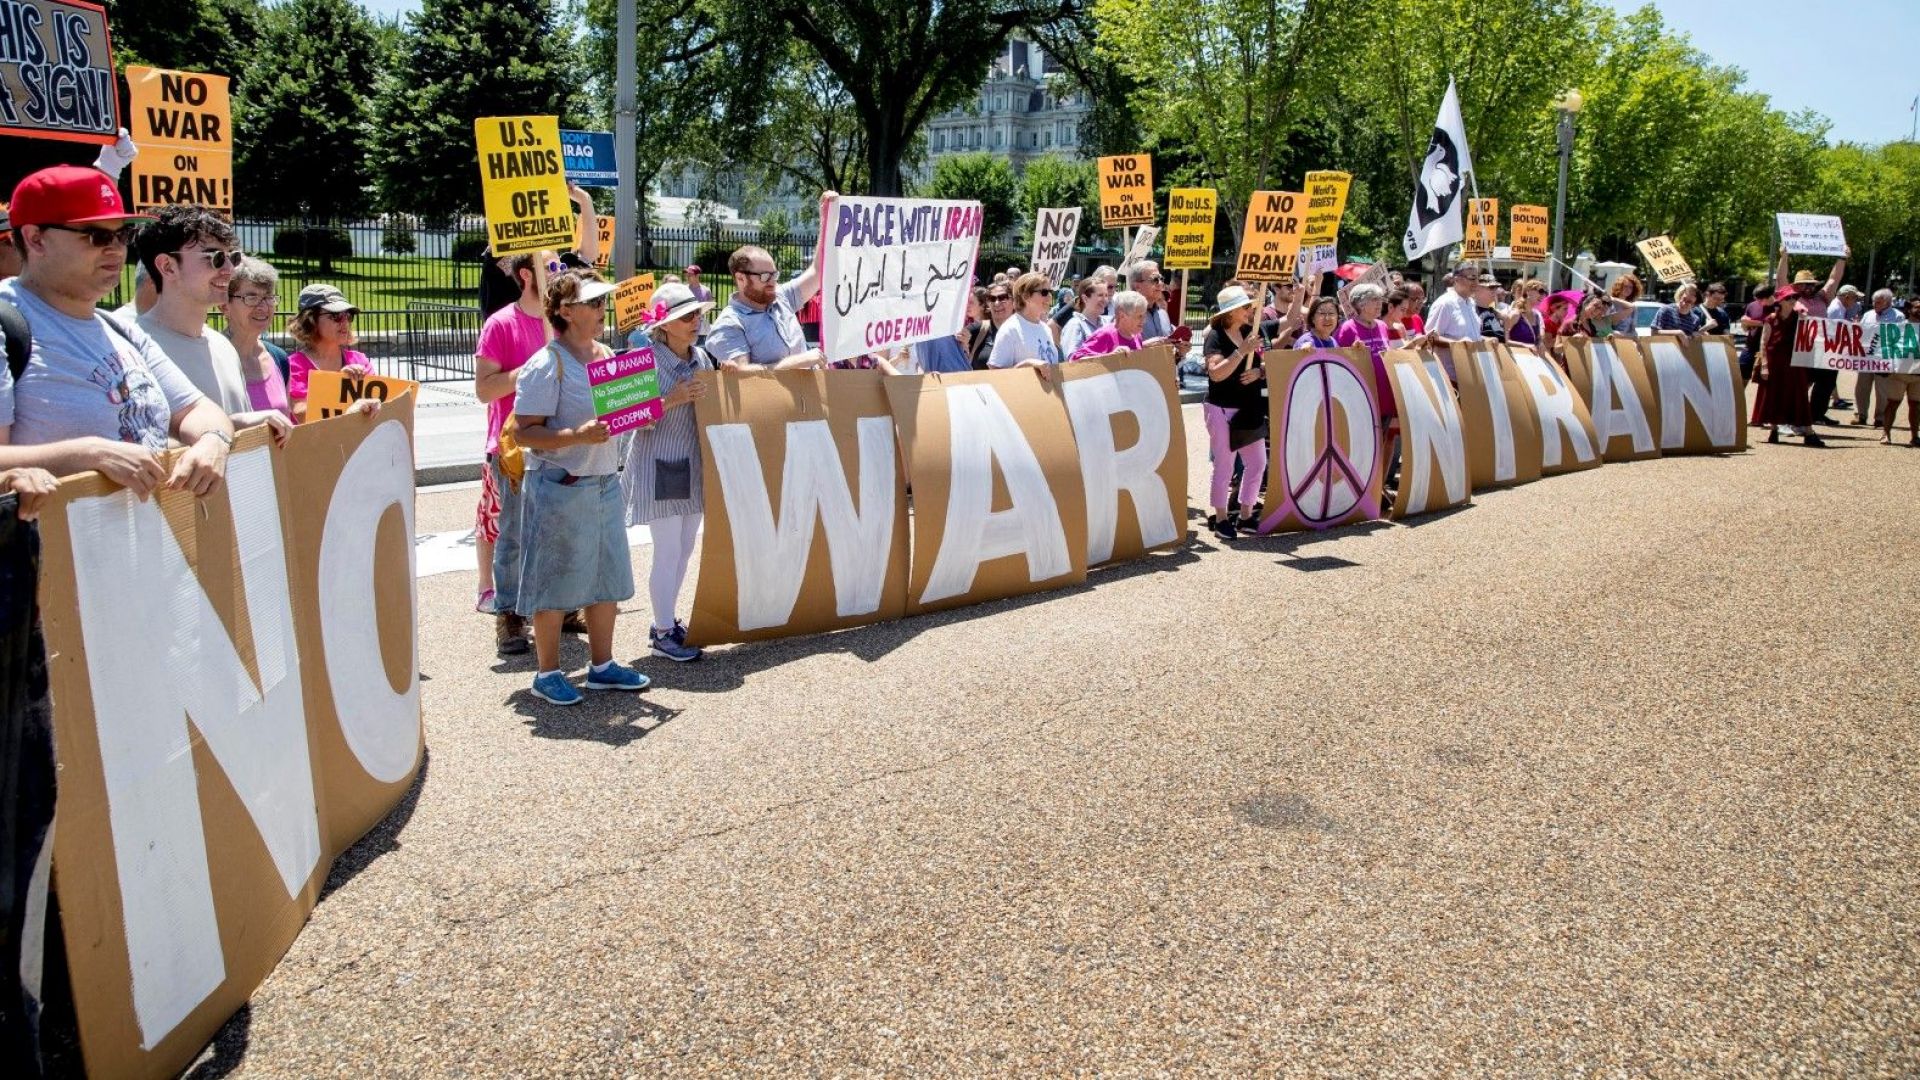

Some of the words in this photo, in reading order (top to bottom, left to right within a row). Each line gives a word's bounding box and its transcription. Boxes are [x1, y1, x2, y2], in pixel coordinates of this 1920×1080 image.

[0, 0, 46, 66] HIS
[53, 11, 91, 69] IS
[19, 62, 113, 131] SIGN!
[160, 73, 207, 106] NO
[147, 107, 221, 142] WAR
[499, 120, 542, 148] U.S.
[561, 133, 591, 144] DON'T
[563, 144, 594, 158] IRAQ
[173, 154, 198, 172] ON
[487, 150, 560, 180] HANDS
[1113, 157, 1137, 172] NO
[1107, 173, 1146, 189] WAR
[138, 175, 229, 206] IRAN!
[1120, 194, 1133, 203] ON
[511, 189, 550, 219] OFF
[1104, 202, 1152, 218] IRAN!
[1172, 195, 1184, 209] NO
[1186, 200, 1193, 209] to
[1194, 198, 1212, 210] U.S.
[1266, 195, 1294, 213] NO
[494, 215, 570, 241] VENEZUELA!
[596, 218, 608, 229] O
[835, 203, 895, 248] PEACE
[900, 205, 943, 245] WITH
[943, 205, 984, 241] IRAN
[1041, 212, 1075, 237] NO
[1170, 213, 1189, 226] coup
[1190, 212, 1212, 226] plots
[1255, 215, 1298, 235] WAR
[1512, 214, 1547, 225] BOLTON
[1173, 232, 1205, 245] against
[1264, 241, 1279, 251] ON
[1520, 235, 1539, 245] WAR
[1647, 239, 1663, 249] NO
[1037, 240, 1072, 260] MORE
[1167, 246, 1210, 258] Venezuela!
[1511, 246, 1546, 255] CRIMINAL
[1649, 247, 1674, 260] WAR
[1240, 253, 1295, 272] IRAN!
[1658, 263, 1690, 277] IRAN!
[901, 250, 913, 299] با
[924, 243, 968, 312] صلح
[615, 282, 654, 300] BOLTON
[835, 253, 887, 317] ایران
[625, 302, 647, 314] WAR
[1795, 319, 1818, 353] NO
[1822, 319, 1866, 358] WAR
[1866, 333, 1881, 356] WITH
[1880, 323, 1920, 360] IRA
[590, 365, 606, 379] WE
[618, 352, 652, 372] IRANIANS
[1828, 358, 1890, 371] CODEPINK
[339, 377, 388, 404] NO
[593, 389, 606, 398] No
[611, 406, 652, 429] CODEPINK
[66, 419, 416, 1051] NO
[706, 368, 1178, 631] WAR
[1285, 357, 1466, 522] ON
[1476, 341, 1737, 482] IRAN
